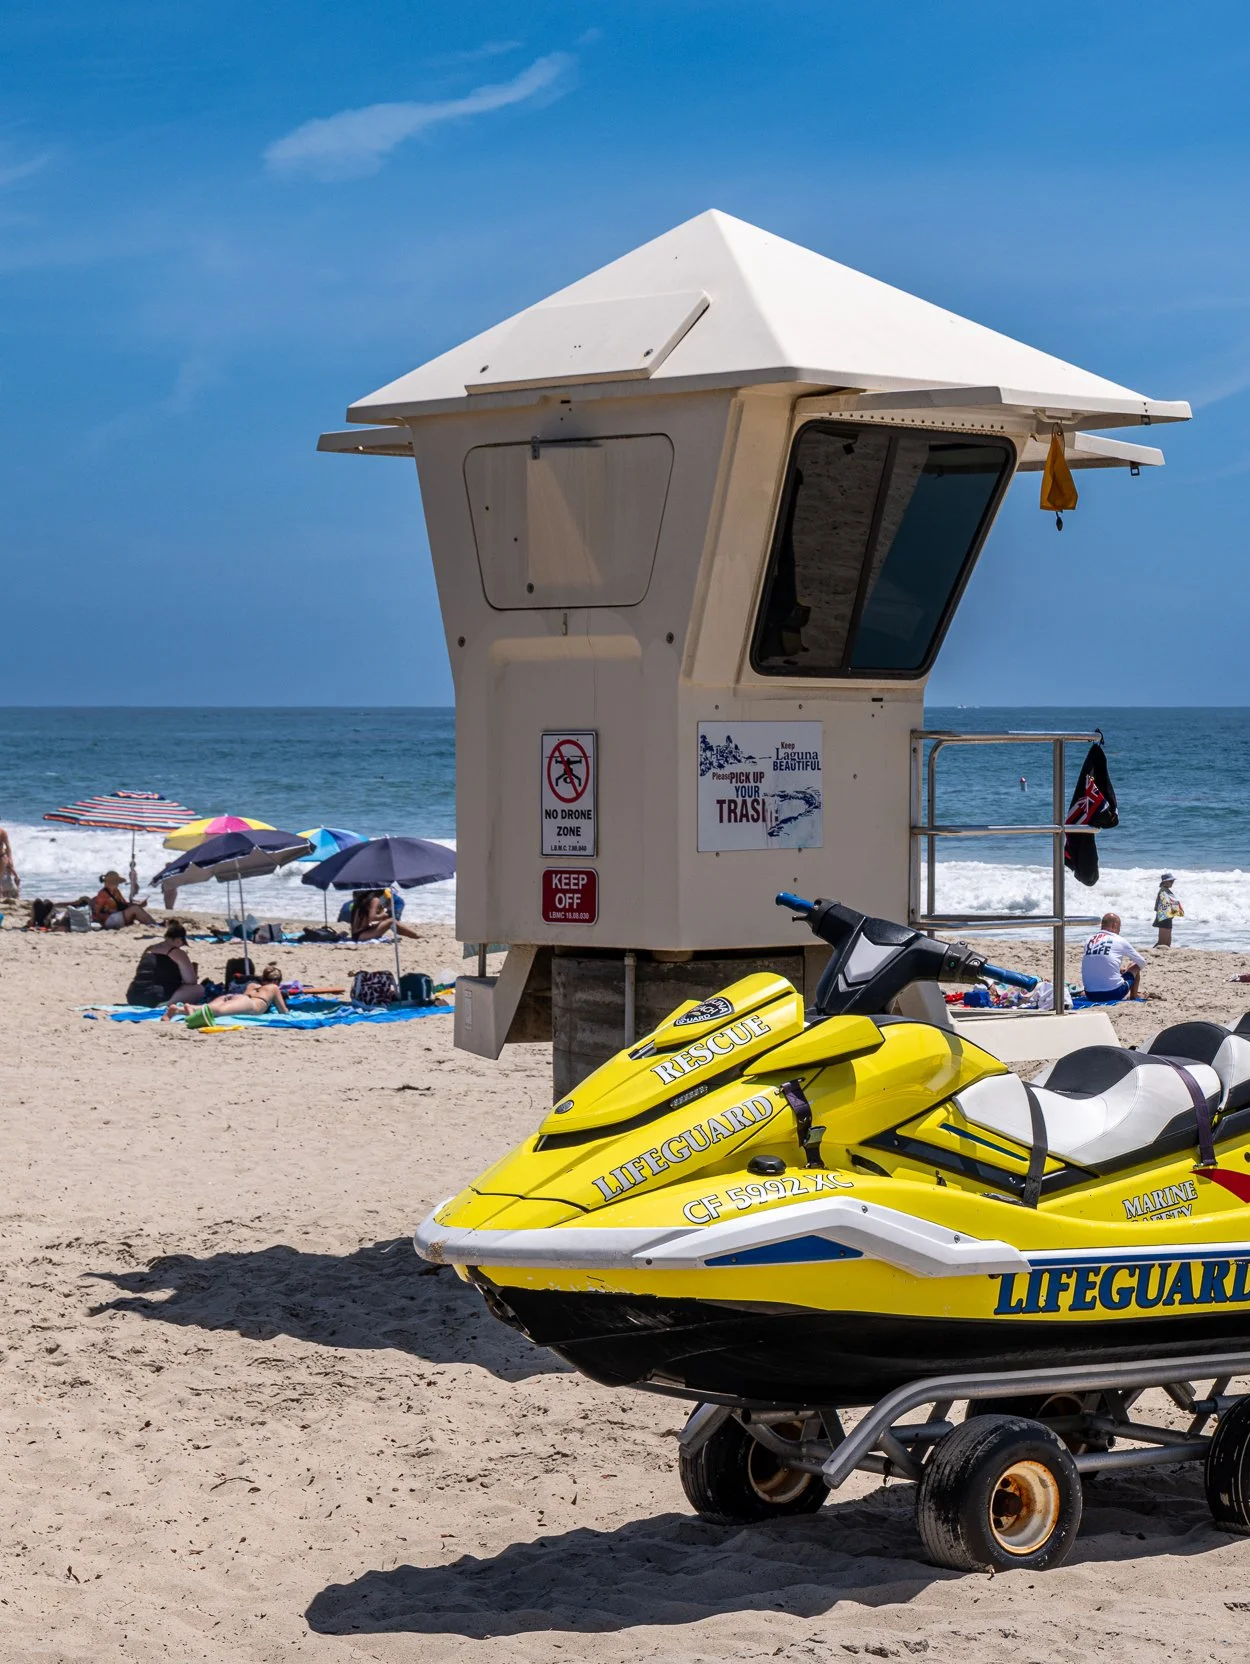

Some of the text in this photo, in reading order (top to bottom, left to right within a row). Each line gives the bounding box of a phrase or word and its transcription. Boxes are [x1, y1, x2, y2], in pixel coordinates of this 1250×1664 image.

[781, 742, 795, 750] Keep
[775, 748, 818, 763] Laguna
[773, 760, 821, 771] BEAUTIFUL
[730, 772, 750, 784] PICK
[753, 772, 765, 784] UP
[735, 786, 760, 798] YOUR
[545, 809, 592, 820] NO DRONE
[556, 826, 581, 836] ZONE
[552, 874, 588, 889] KEEP
[555, 893, 582, 909] OFF
[549, 911, 565, 919] LBMC
[650, 1015, 772, 1085] RESCUE
[592, 1095, 774, 1202] LIFEGUARD
[683, 1173, 854, 1224] CF 5992 XC
[1122, 1180, 1198, 1219] MARINE
